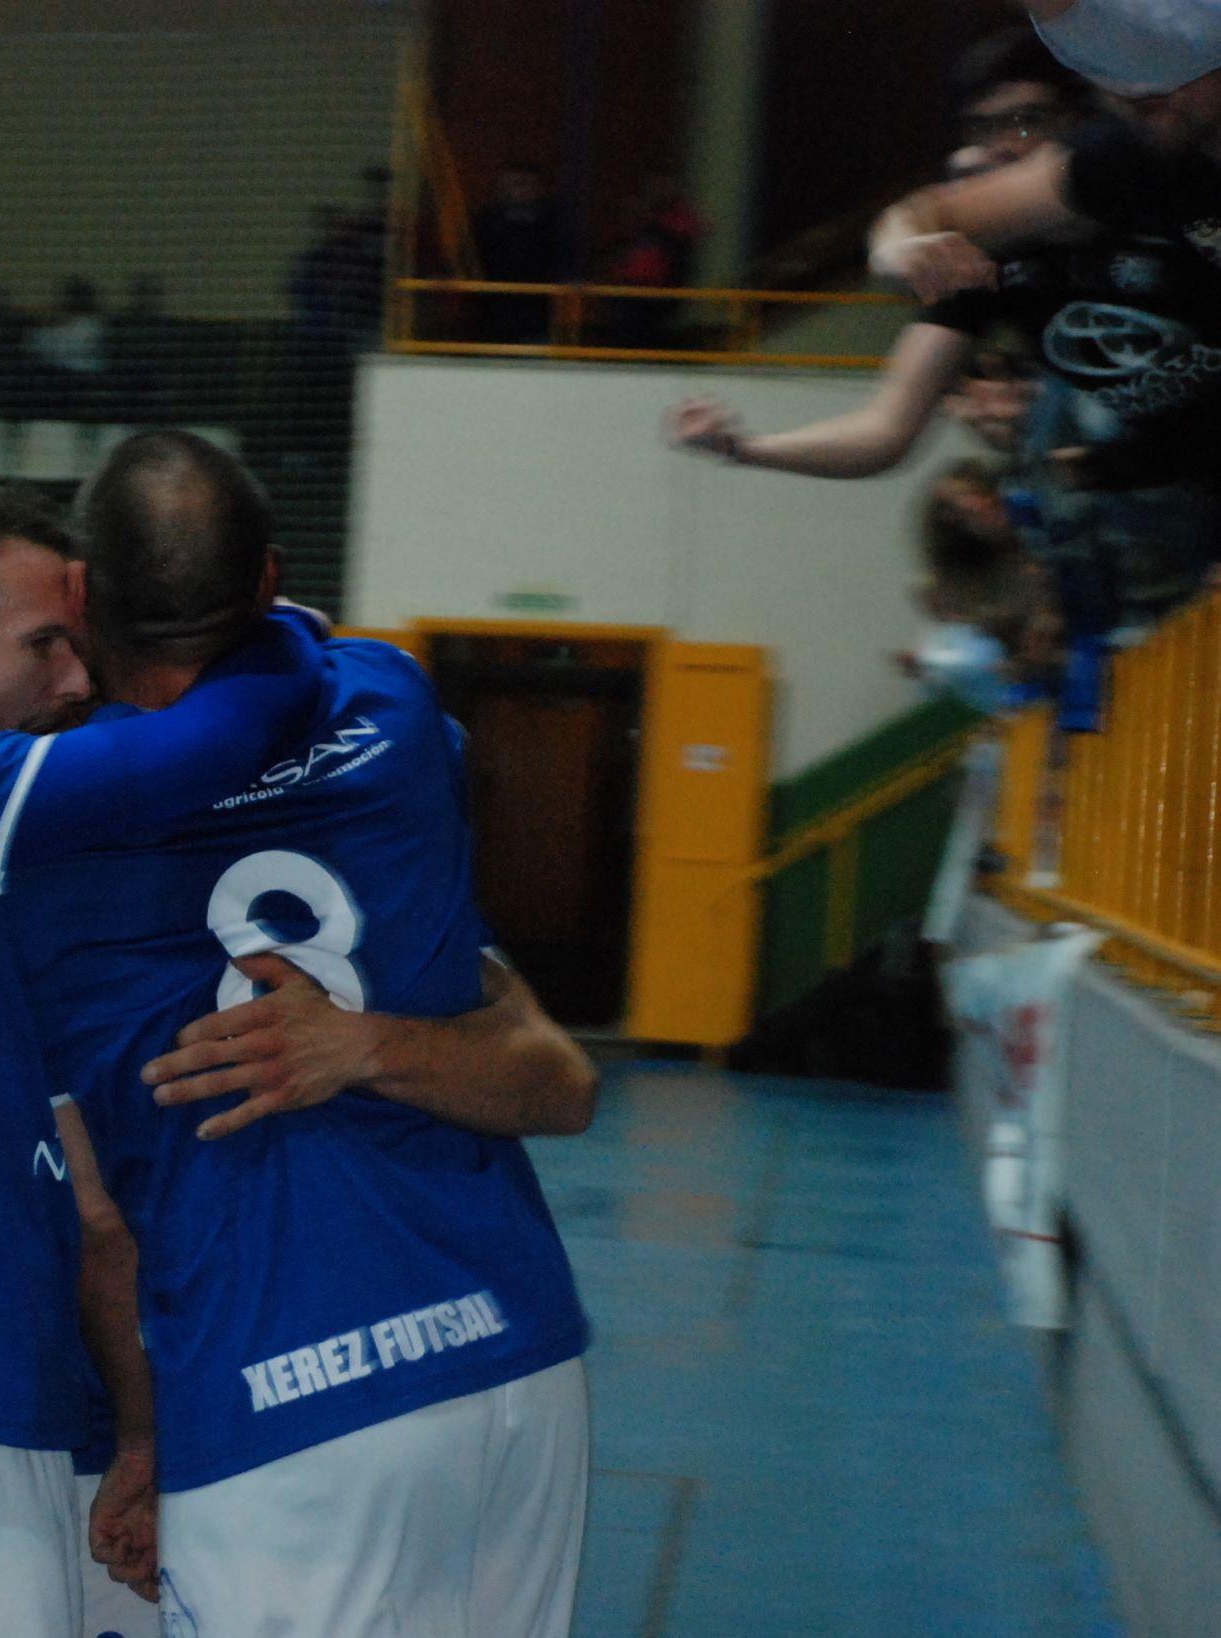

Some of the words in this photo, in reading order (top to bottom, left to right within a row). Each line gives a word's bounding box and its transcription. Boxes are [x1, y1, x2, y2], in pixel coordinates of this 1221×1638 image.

[207, 849, 365, 1014] 8
[241, 1326, 374, 1413] XEREZ
[370, 1289, 509, 1370] FUTSAL
